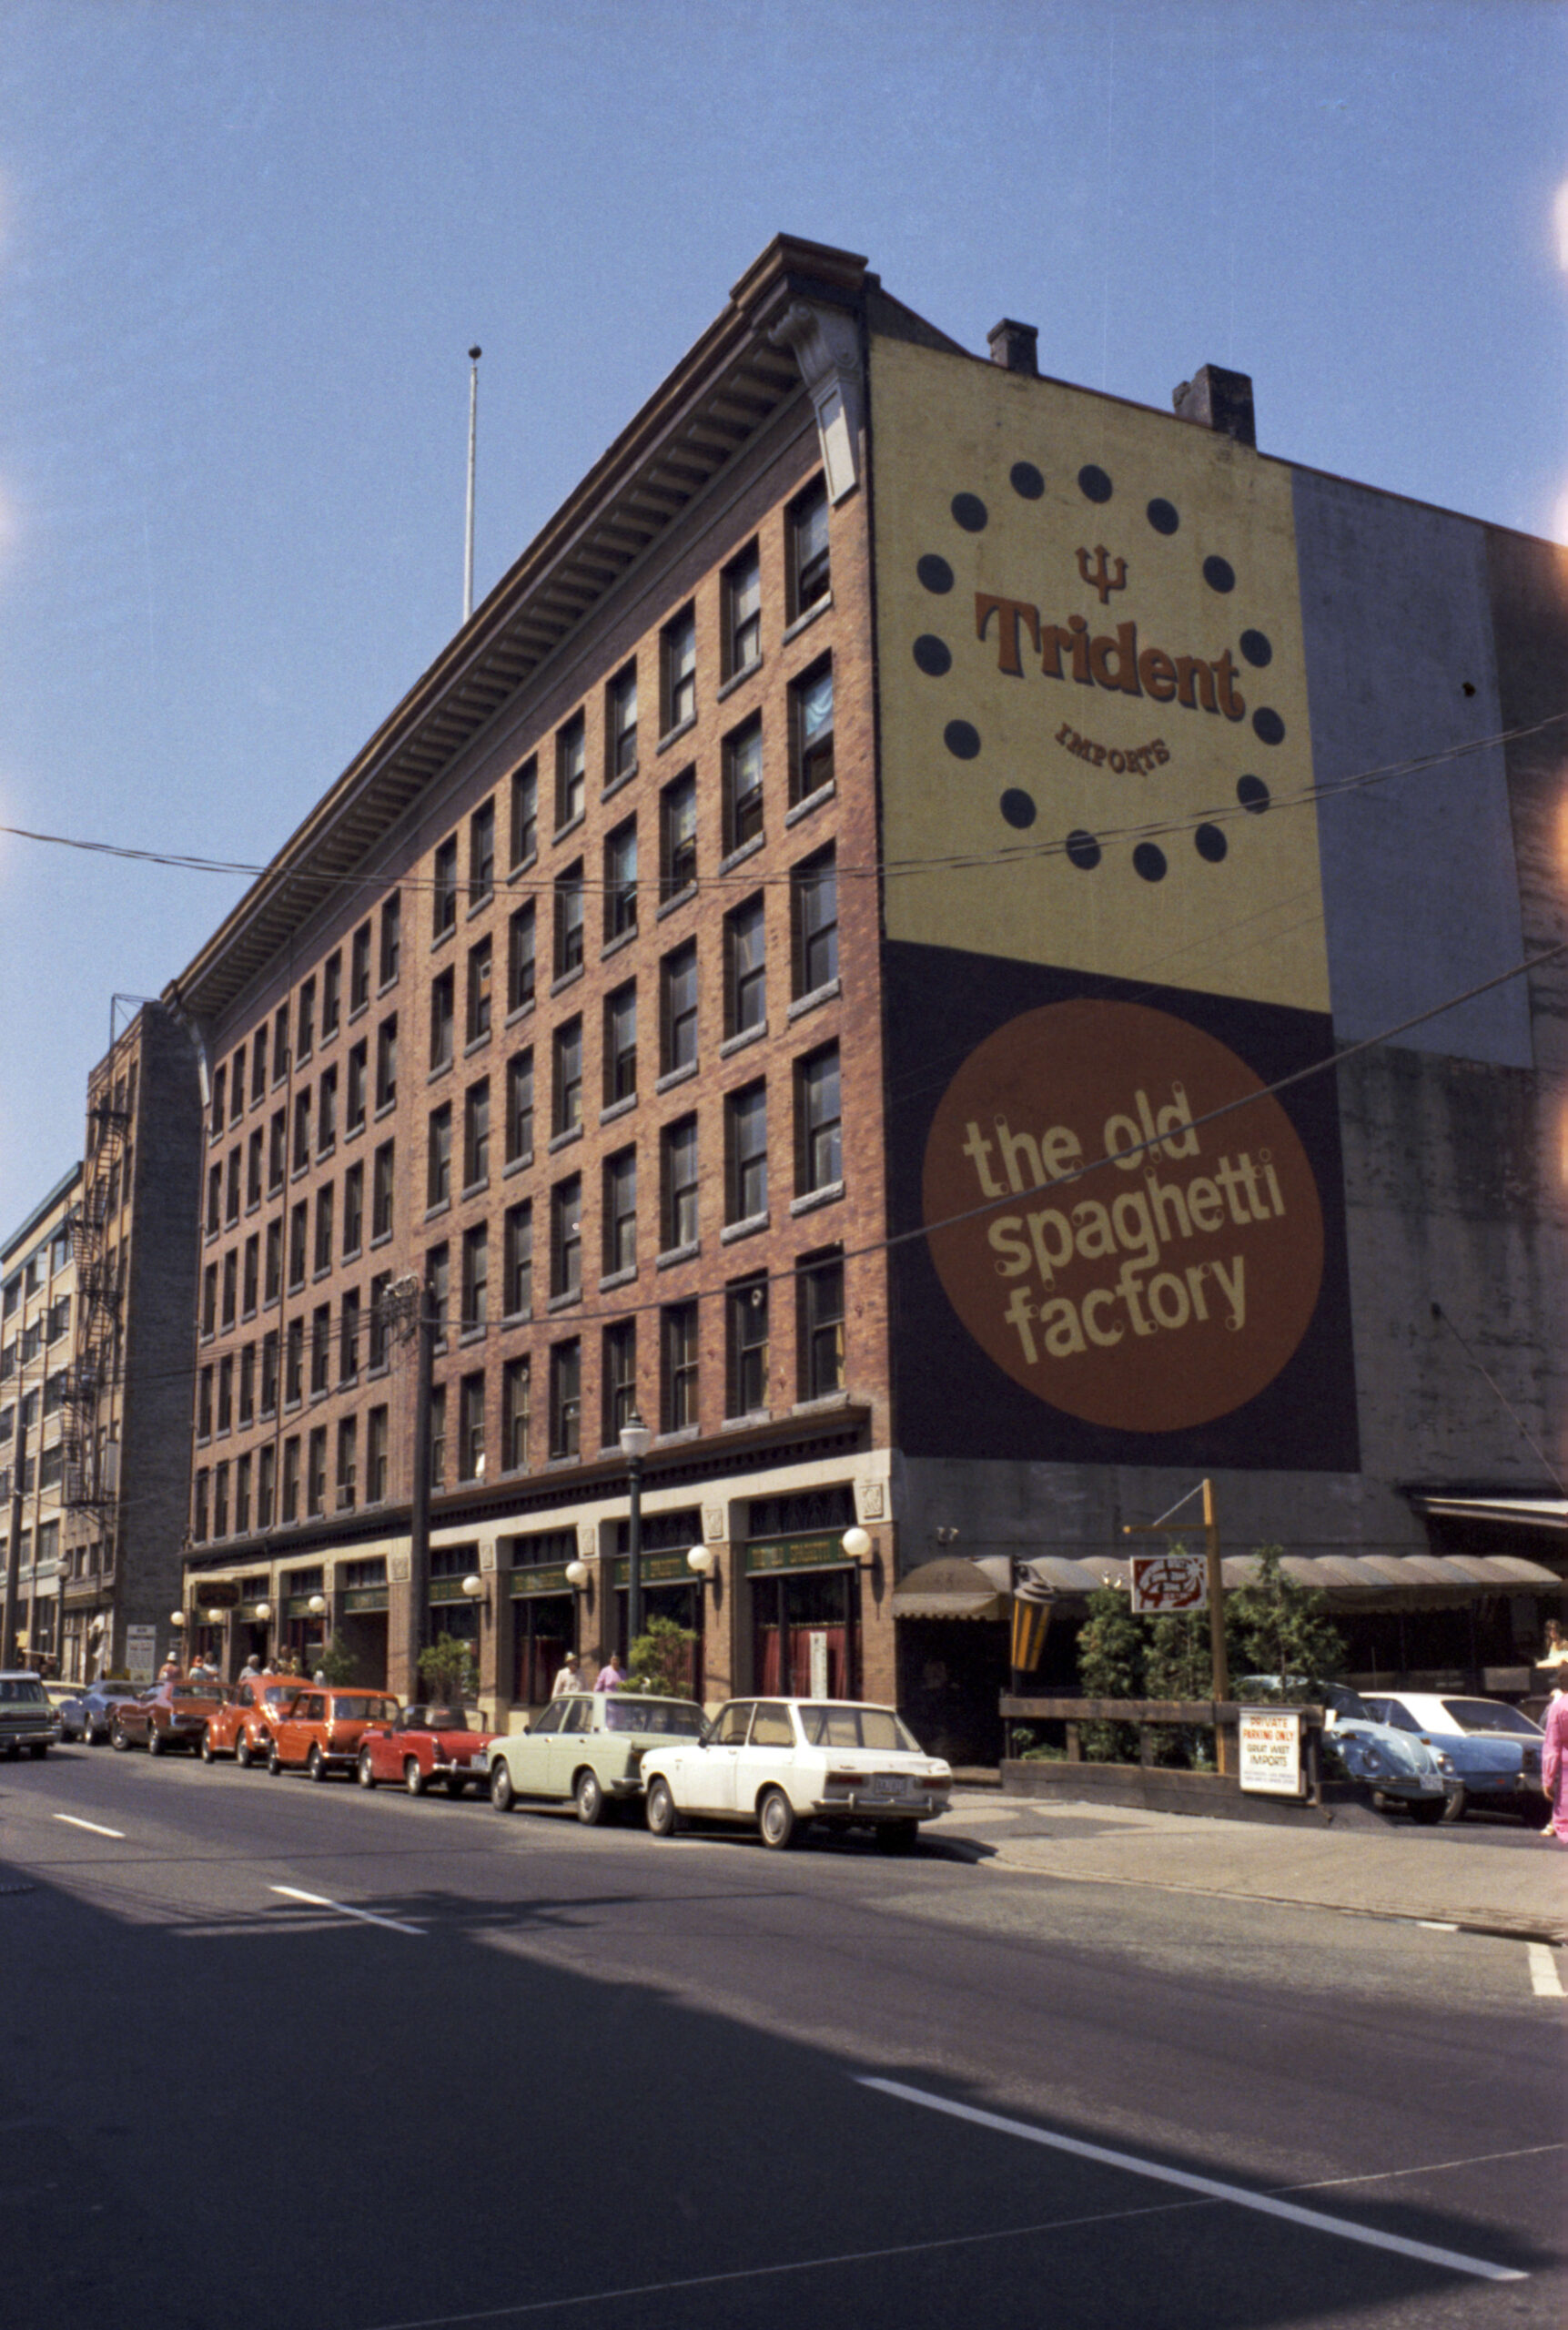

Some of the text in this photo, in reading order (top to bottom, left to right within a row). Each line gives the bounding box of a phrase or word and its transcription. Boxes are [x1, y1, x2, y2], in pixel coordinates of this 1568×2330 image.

[975, 592, 1246, 722] Trident
[1054, 722, 1170, 776] IMPORTS
[963, 1080, 1201, 1199] the old
[987, 1148, 1286, 1292] spaghetti
[1004, 1255, 1247, 1364] factory
